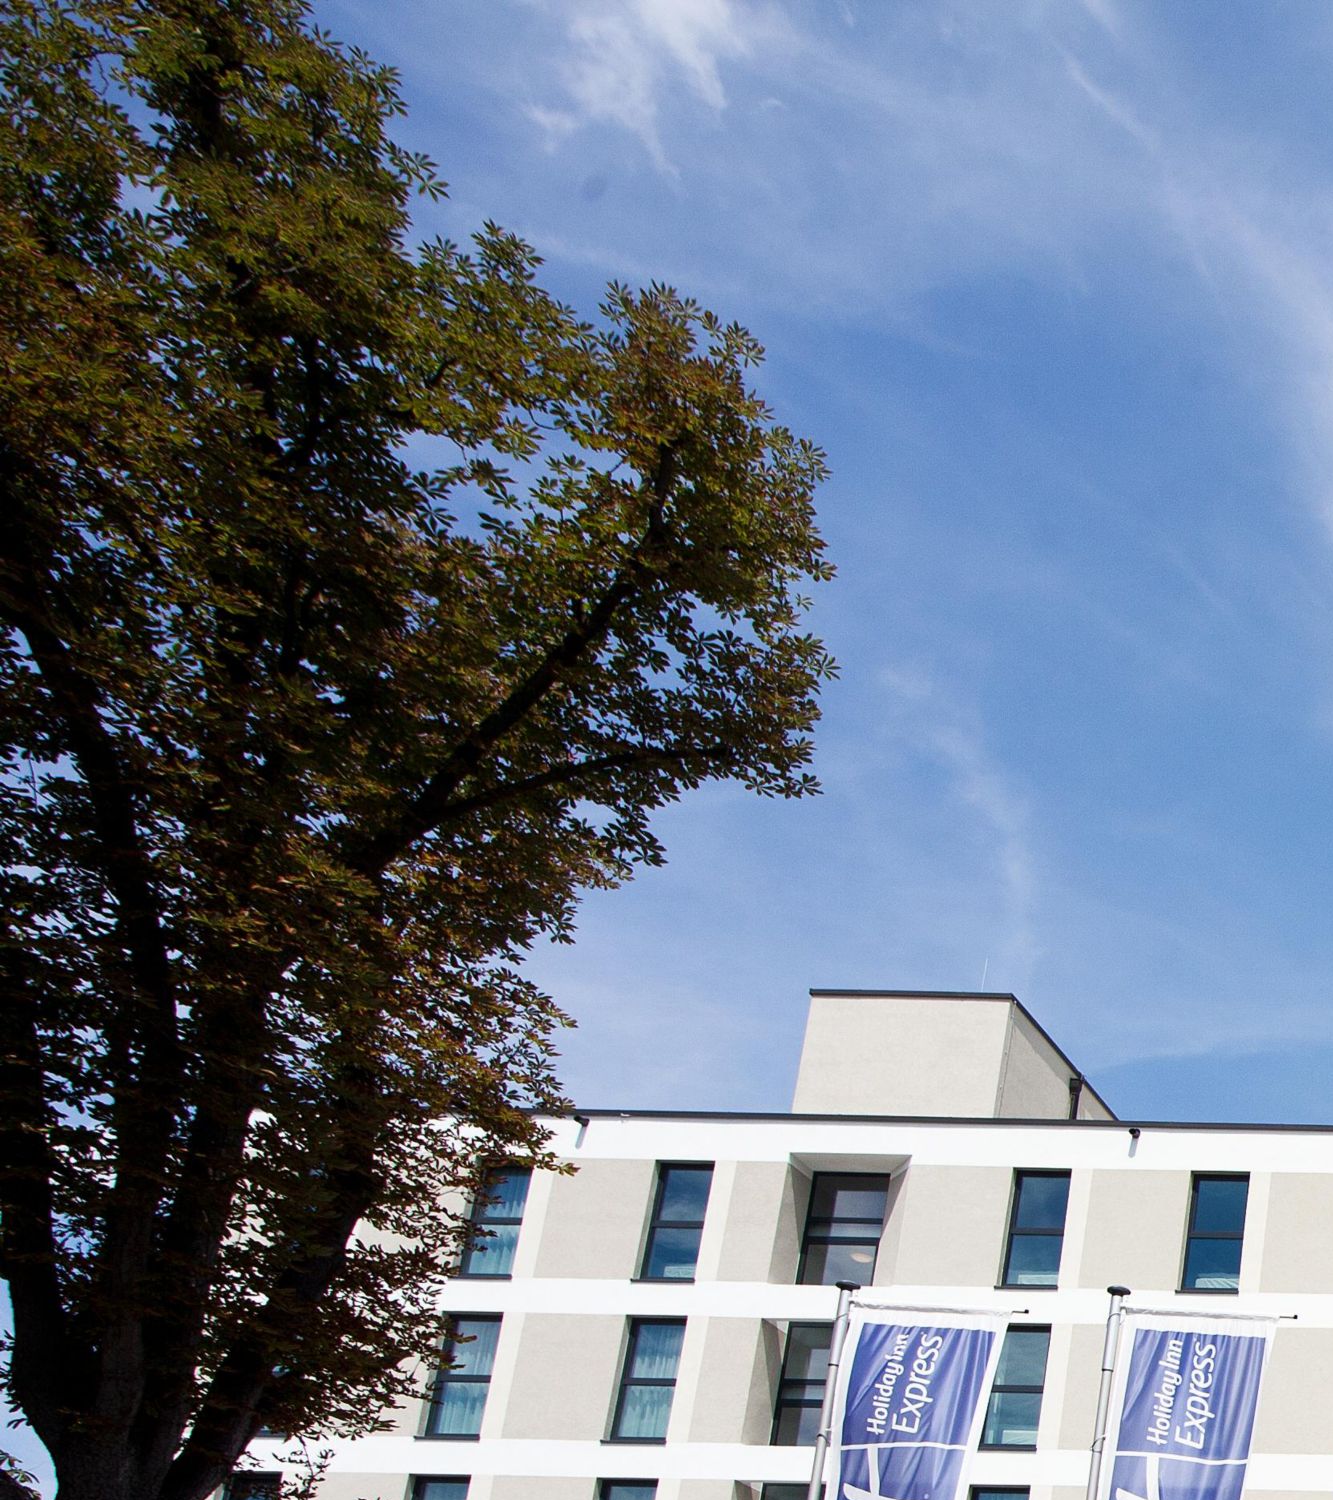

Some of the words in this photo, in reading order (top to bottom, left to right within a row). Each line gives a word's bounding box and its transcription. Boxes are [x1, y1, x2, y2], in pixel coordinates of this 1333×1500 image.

[885, 1333, 910, 1361] Inn
[891, 1333, 943, 1434] Express
[1158, 1339, 1184, 1370] Inn
[866, 1362, 905, 1435] Holiday
[1146, 1370, 1183, 1445] Holiday
[1174, 1341, 1217, 1450] Express
